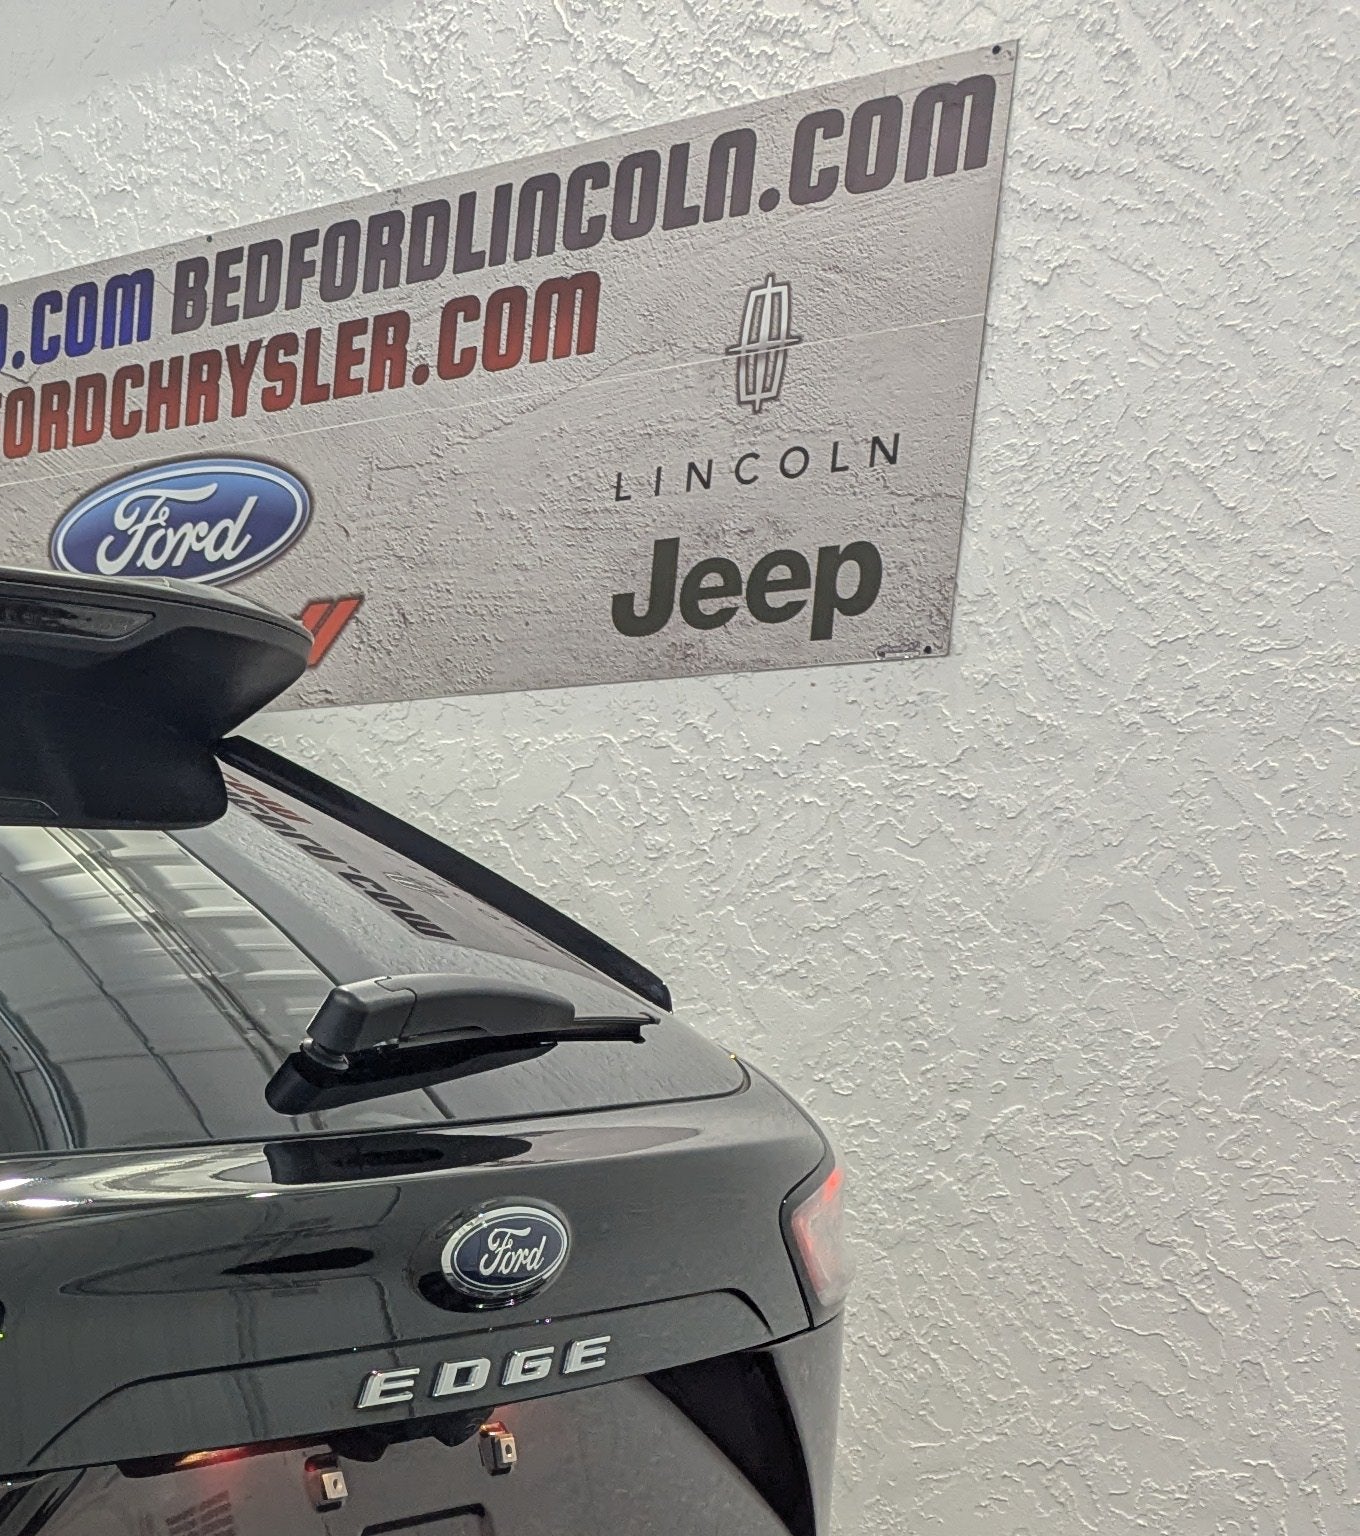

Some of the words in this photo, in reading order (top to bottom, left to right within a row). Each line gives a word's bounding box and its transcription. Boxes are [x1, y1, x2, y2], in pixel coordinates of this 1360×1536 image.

[171, 73, 997, 335] BEDFORDLINCOLN.COM
[615, 432, 901, 502] LINCOLN
[95, 482, 260, 576] Ford
[611, 536, 883, 642] Jeep
[479, 1226, 548, 1276] Ford
[356, 1334, 612, 1410] EDGE
